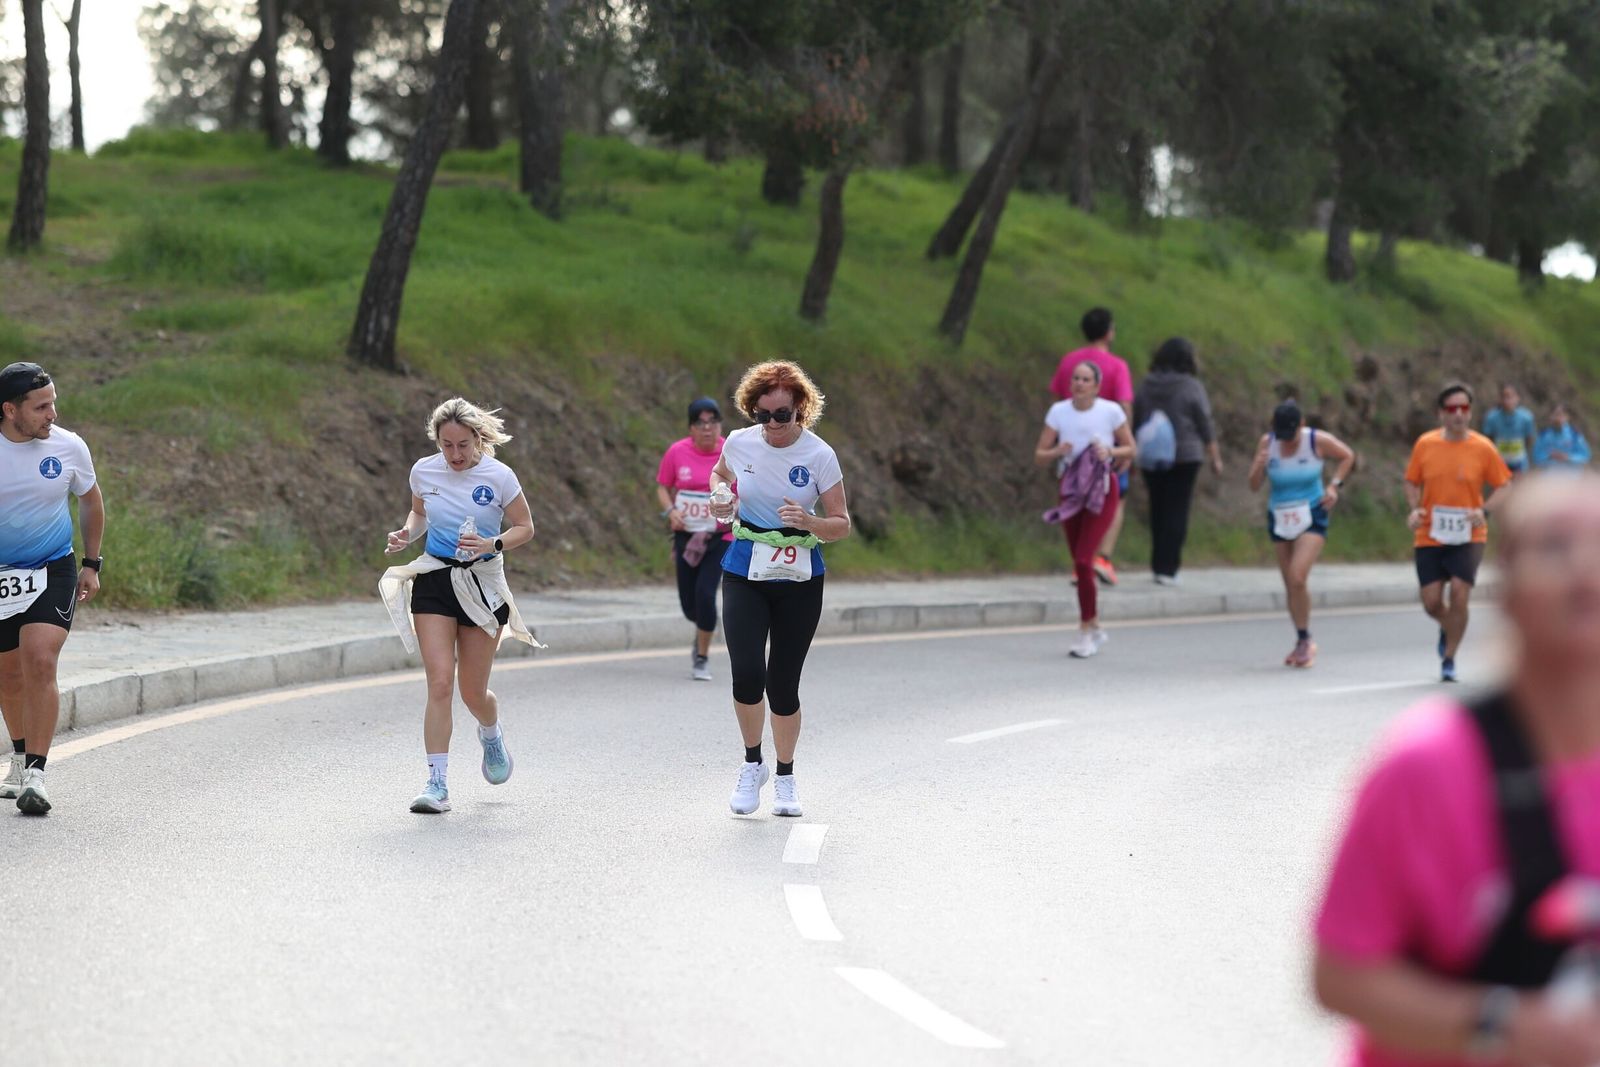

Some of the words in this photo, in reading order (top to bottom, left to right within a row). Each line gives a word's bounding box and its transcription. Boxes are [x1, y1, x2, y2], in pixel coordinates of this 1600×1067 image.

[682, 501, 710, 519] 203
[1439, 517, 1466, 532] 315
[770, 545, 797, 565] 79
[0, 575, 37, 599] 631
